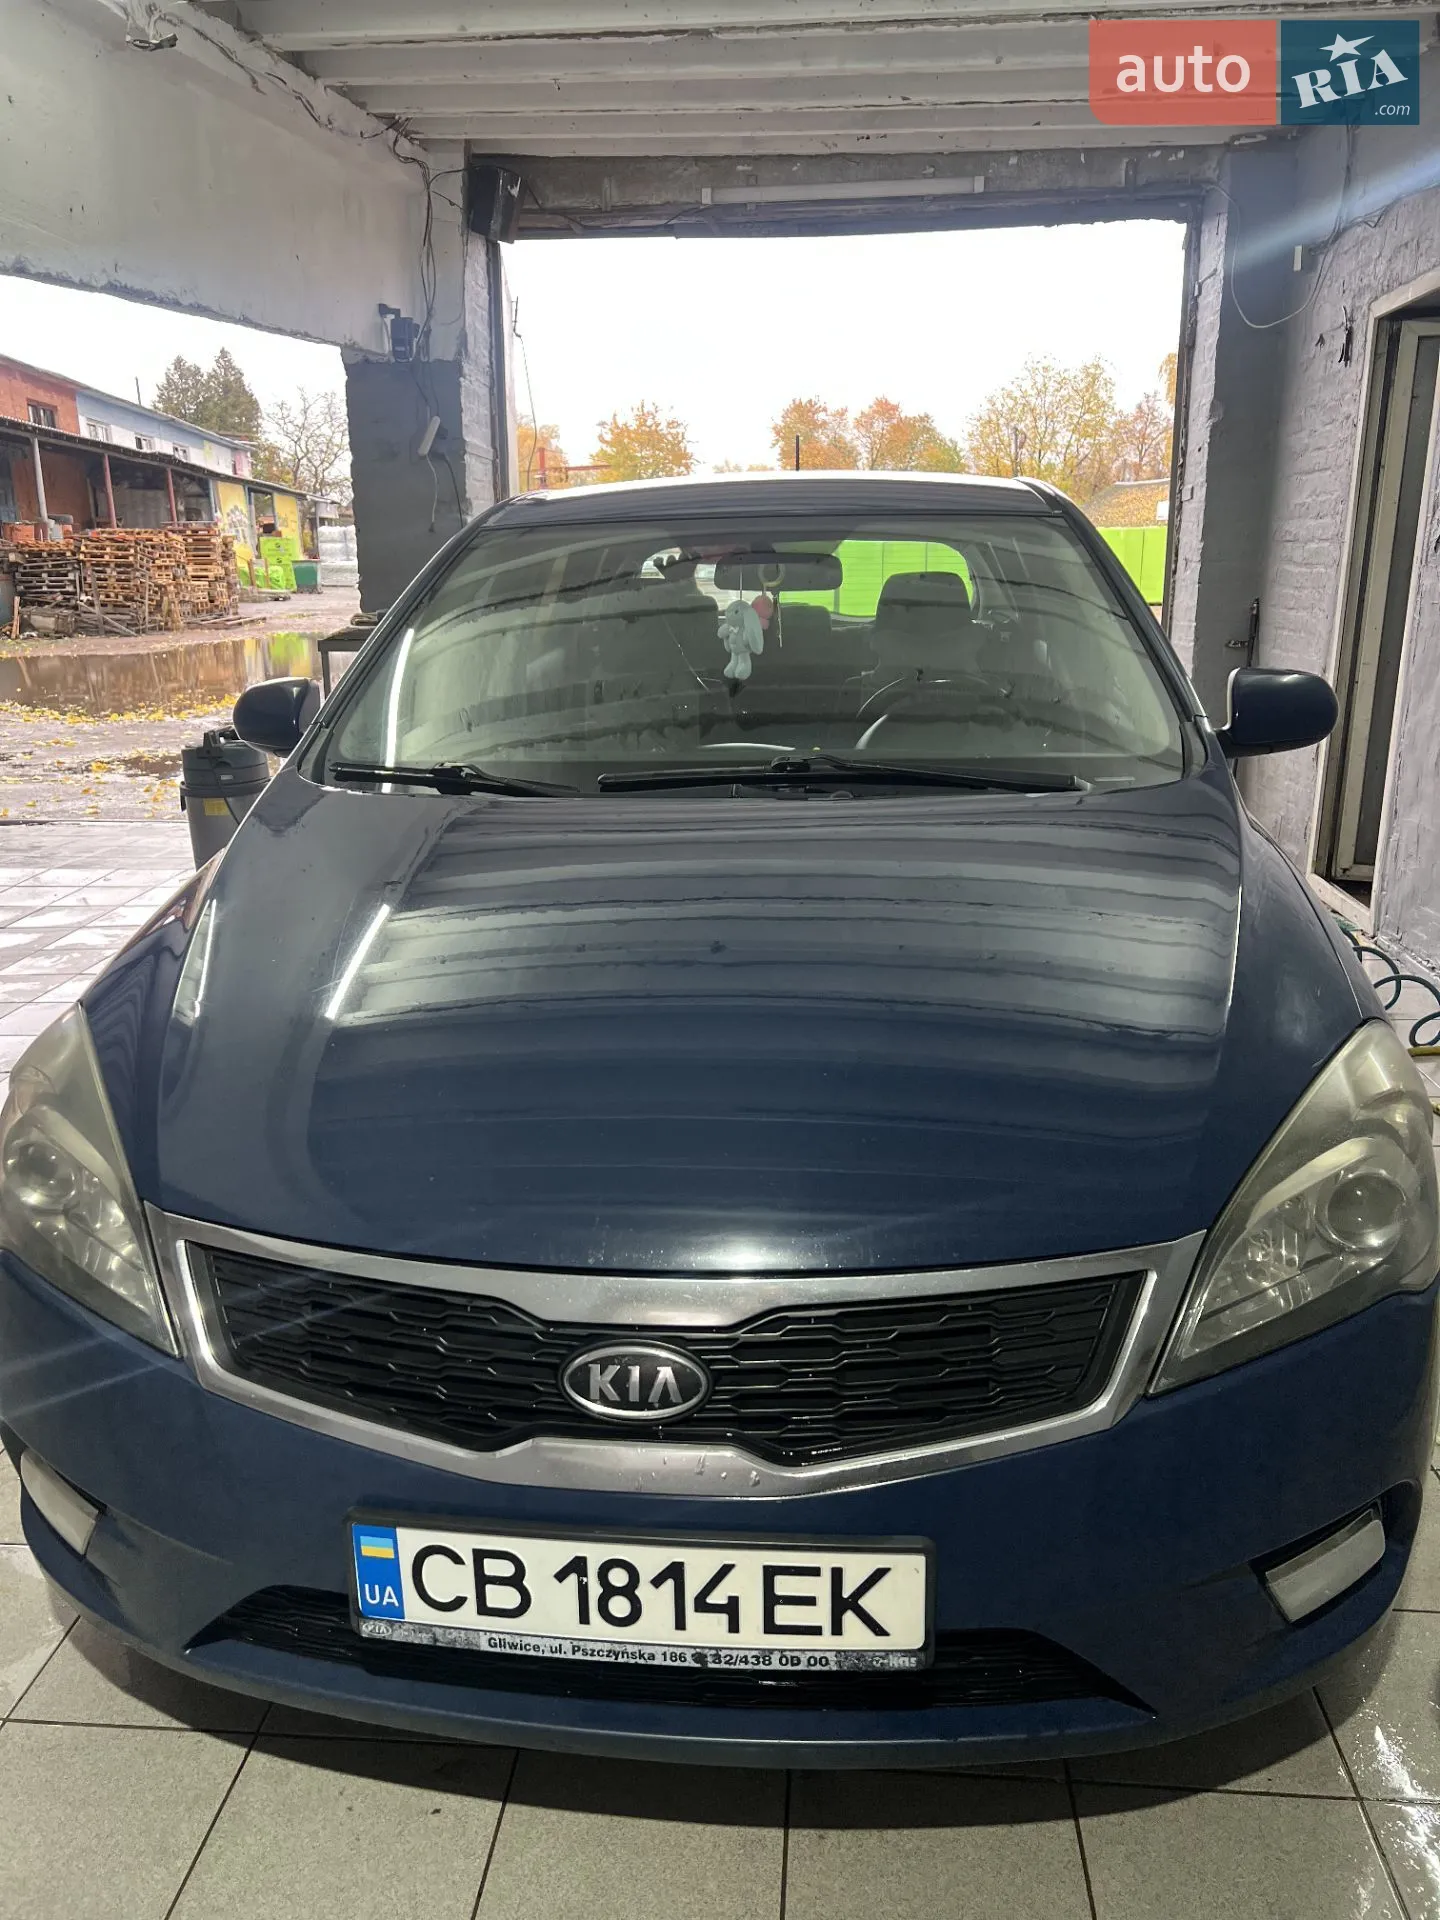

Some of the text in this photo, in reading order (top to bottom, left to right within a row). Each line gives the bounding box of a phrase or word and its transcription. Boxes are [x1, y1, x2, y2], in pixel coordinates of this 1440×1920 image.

[588, 1363, 684, 1403] KIA
[364, 1583, 399, 1608] UA
[411, 1544, 892, 1637] CB 1814 EK
[488, 1636, 546, 1655] Gliwice,
[550, 1643, 567, 1656] ul.
[571, 1644, 656, 1662] Pszczyńska
[661, 1651, 687, 1663] 186
